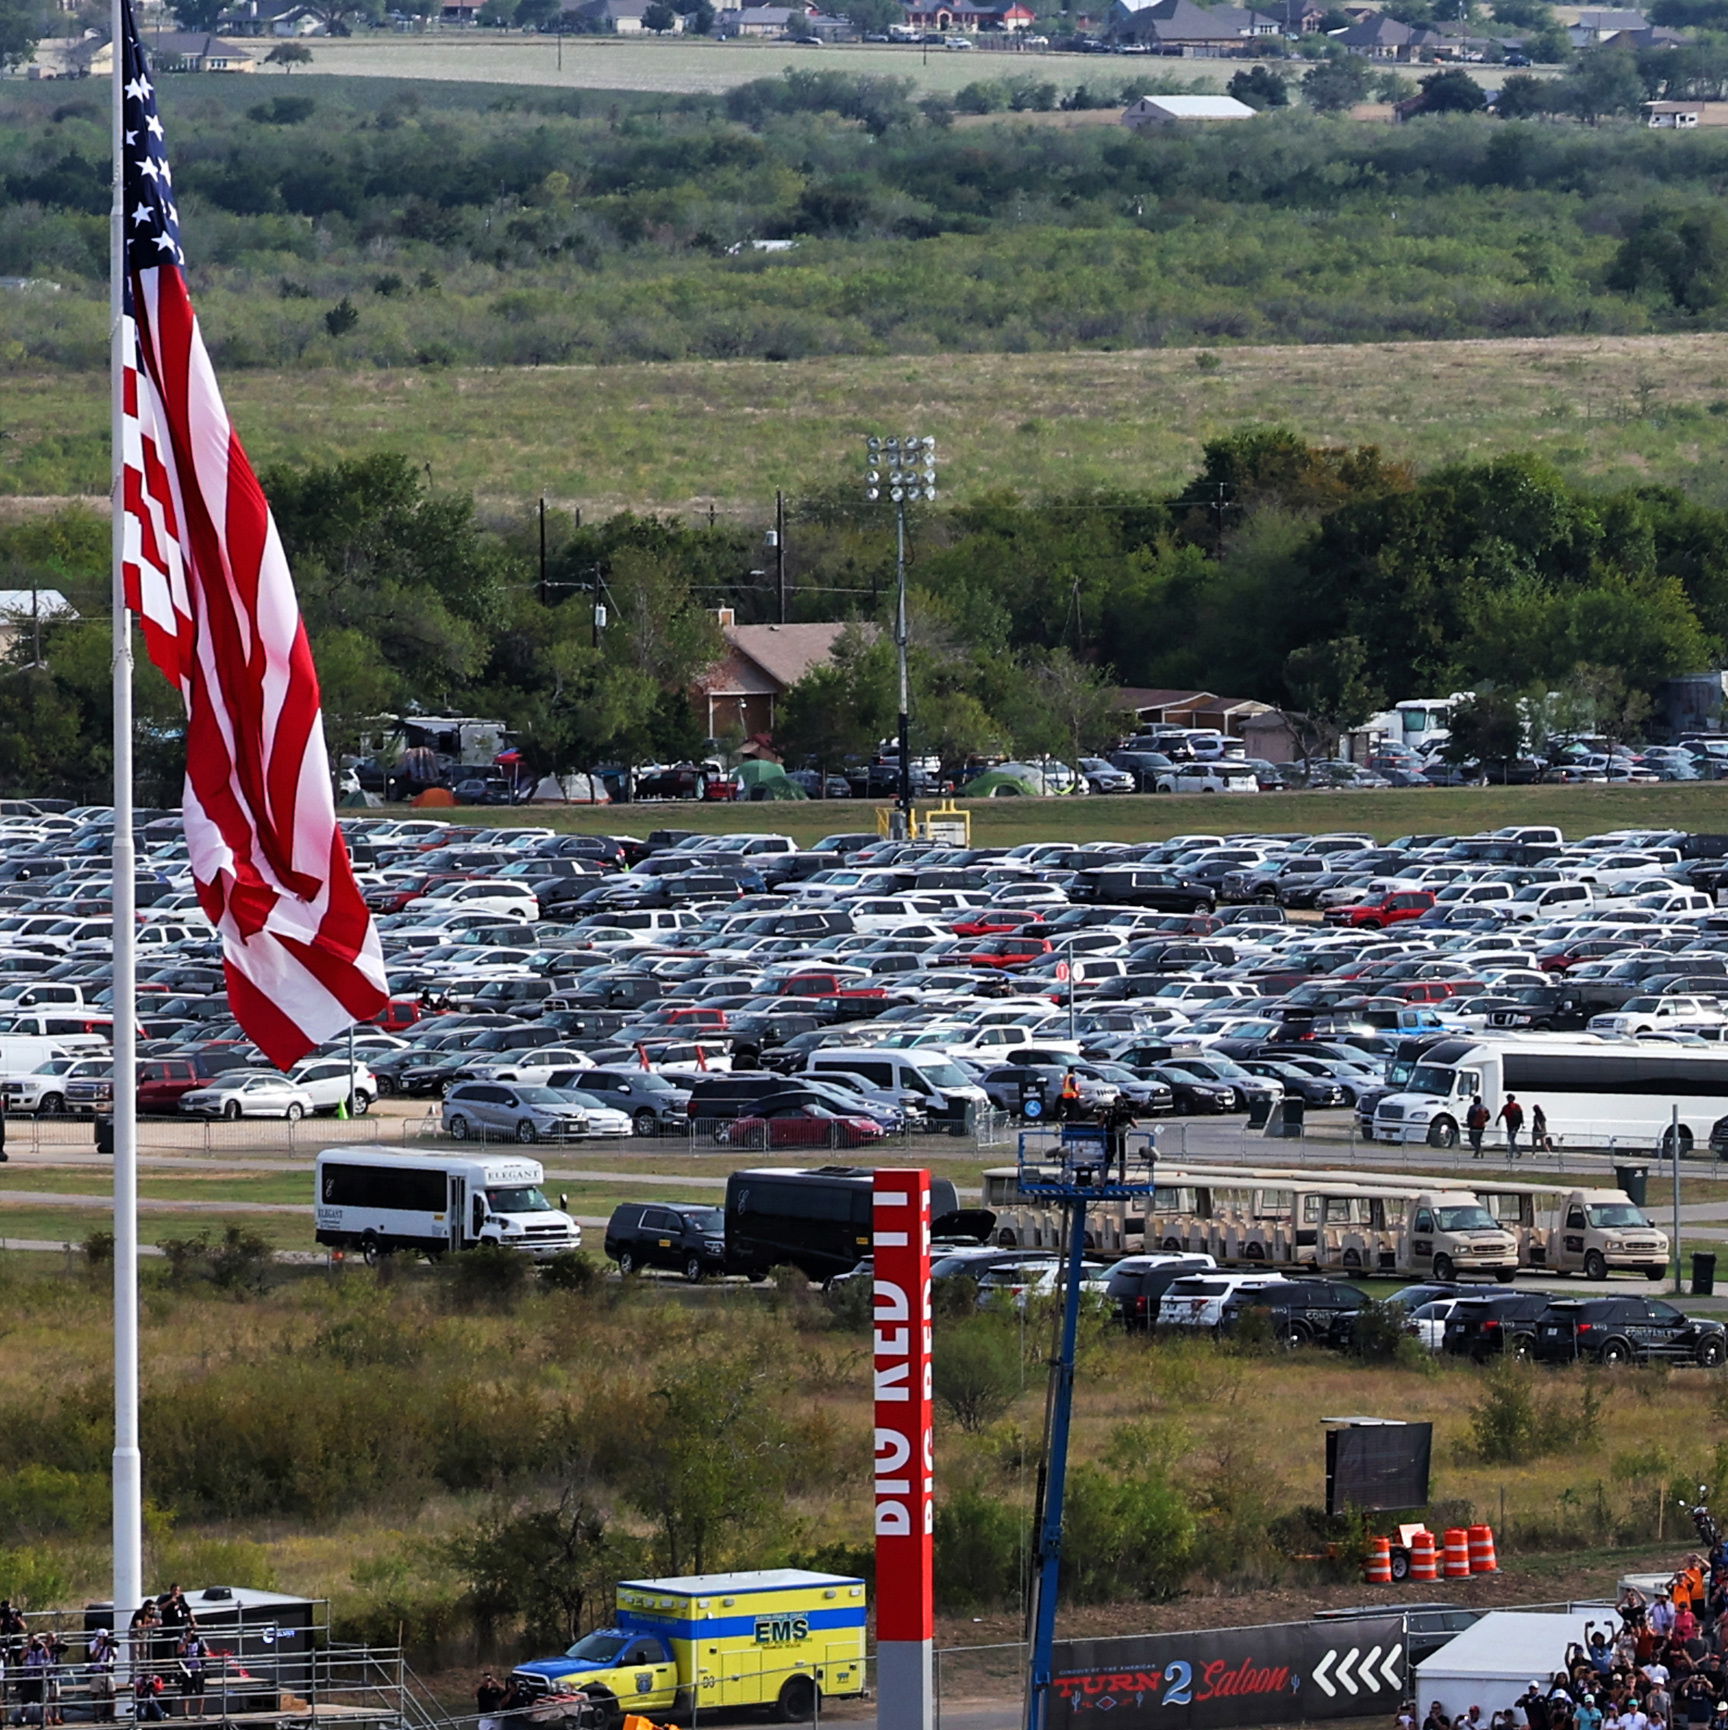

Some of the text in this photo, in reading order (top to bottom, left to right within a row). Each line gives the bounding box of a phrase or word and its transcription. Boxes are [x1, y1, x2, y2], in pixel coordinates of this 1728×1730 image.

[488, 1170, 539, 1182] ELEGANT
[754, 1619, 809, 1643] EMS
[1053, 1657, 1290, 1706] TURN 2 Saloon
